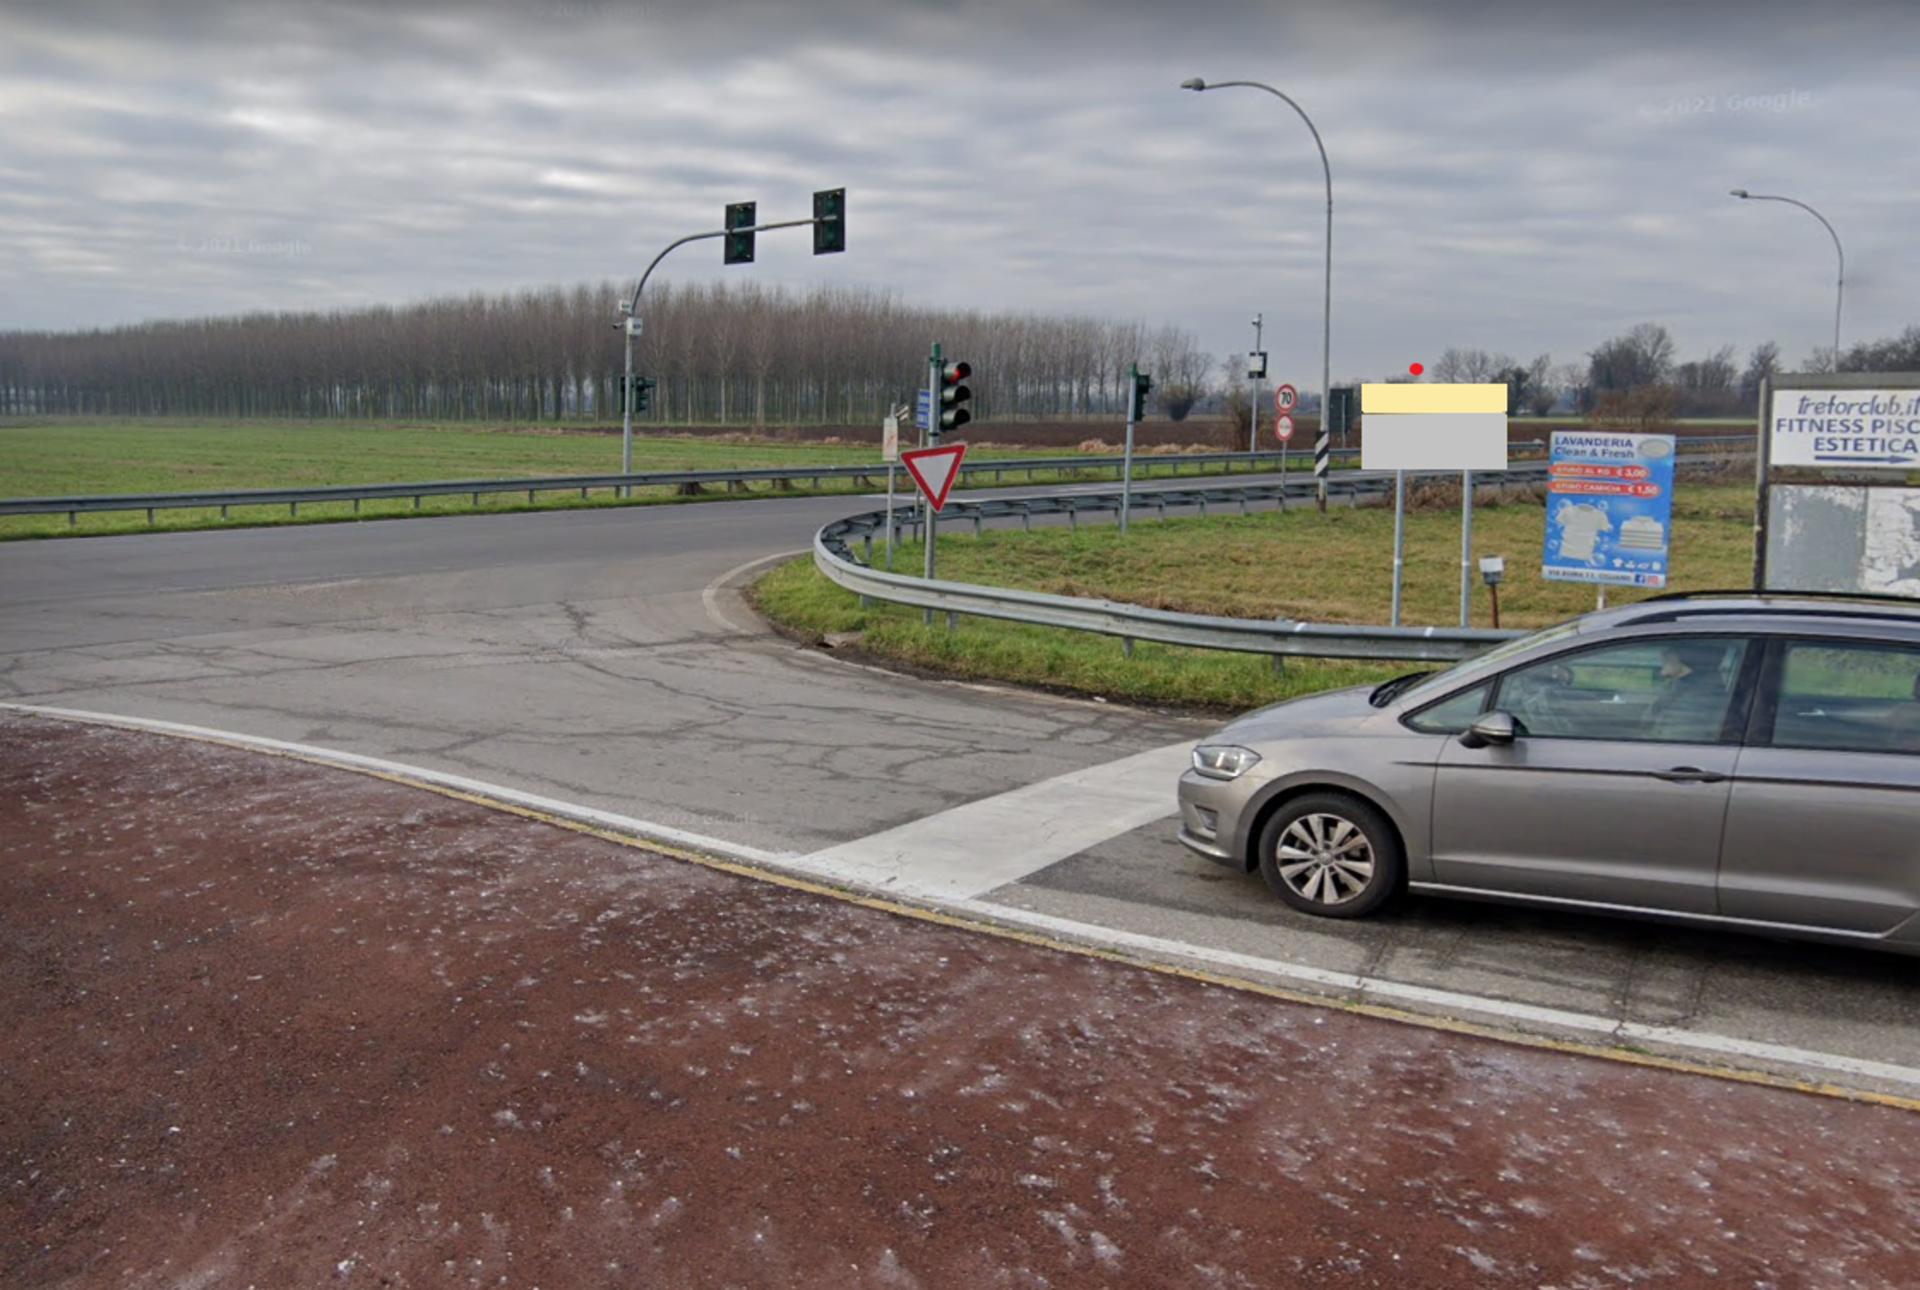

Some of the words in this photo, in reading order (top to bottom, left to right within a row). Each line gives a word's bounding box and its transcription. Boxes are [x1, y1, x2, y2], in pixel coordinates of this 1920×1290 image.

[1280, 391, 1292, 405] 70
[1776, 418, 1865, 434] FITNESS
[1871, 418, 1920, 435] PISC
[1554, 436, 1634, 448] LAVANDERIA
[1814, 437, 1918, 453] ESTETICA
[1554, 447, 1587, 457] Clean
[1590, 448, 1598, 457] &
[1601, 448, 1635, 458] Fresh
